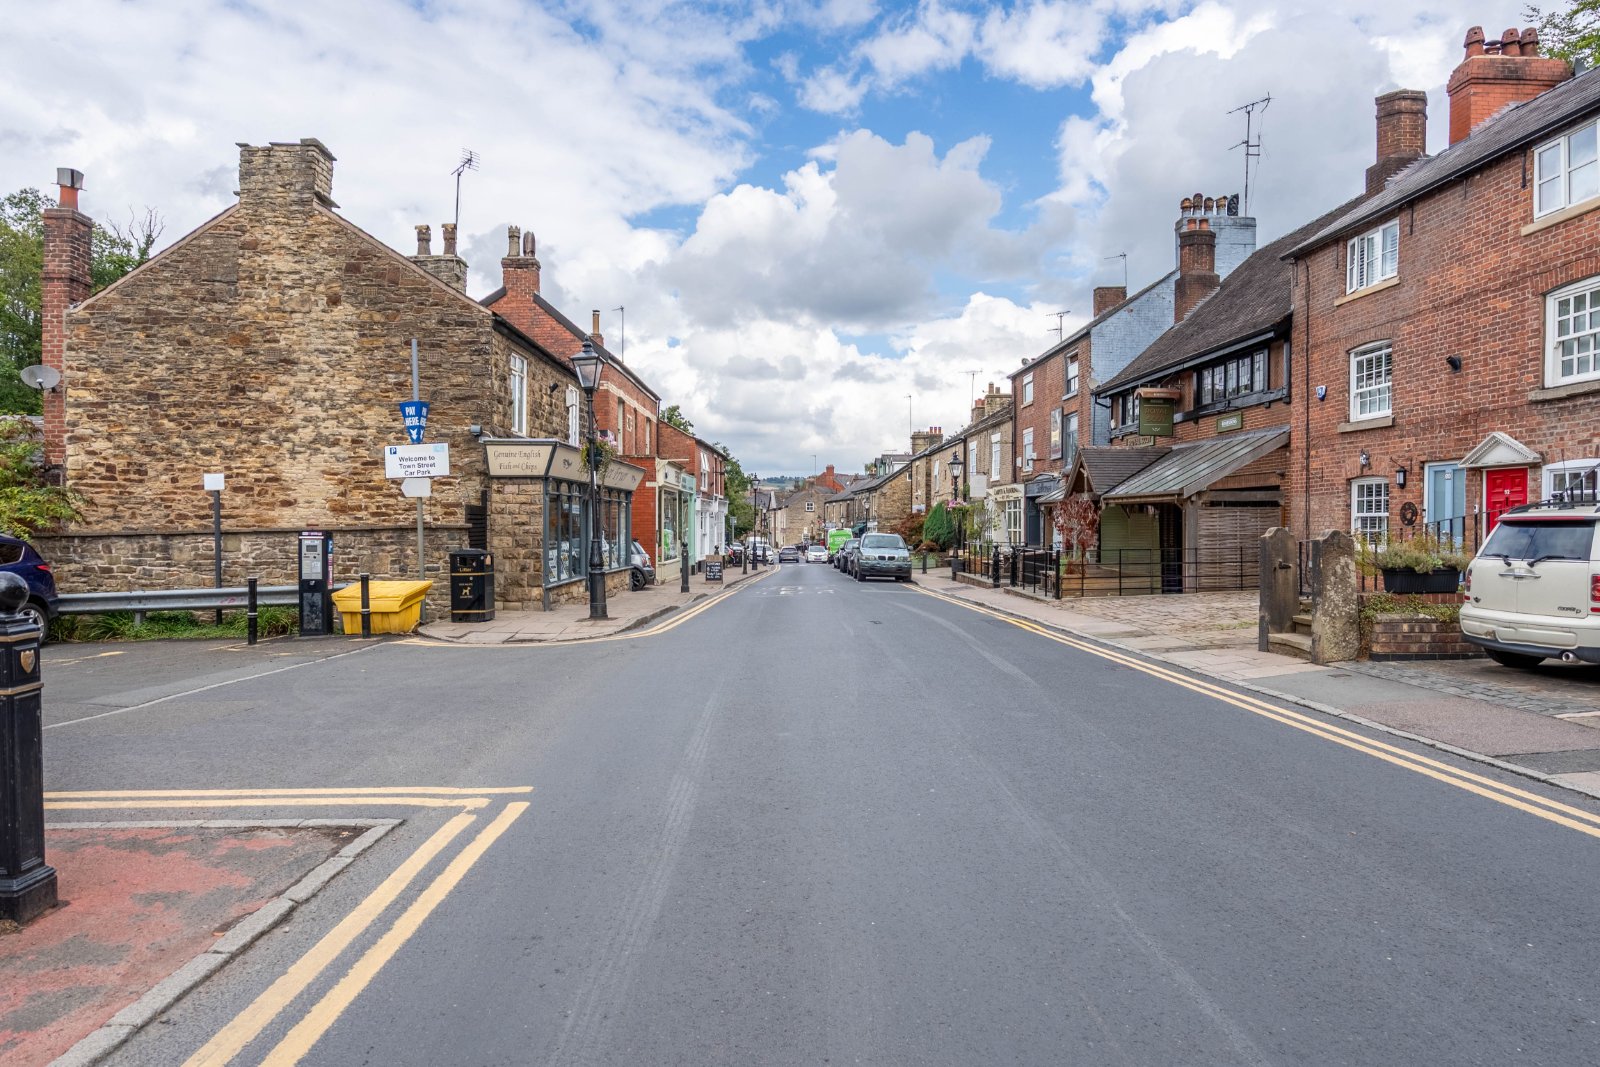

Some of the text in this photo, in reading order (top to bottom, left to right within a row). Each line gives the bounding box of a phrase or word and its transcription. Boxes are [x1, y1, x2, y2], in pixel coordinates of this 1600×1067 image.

[405, 406, 416, 416] PAY
[405, 416, 420, 426] HERE
[494, 450, 542, 460] Genuine English
[500, 462, 512, 470] Fish
[520, 462, 538, 472] Chips
